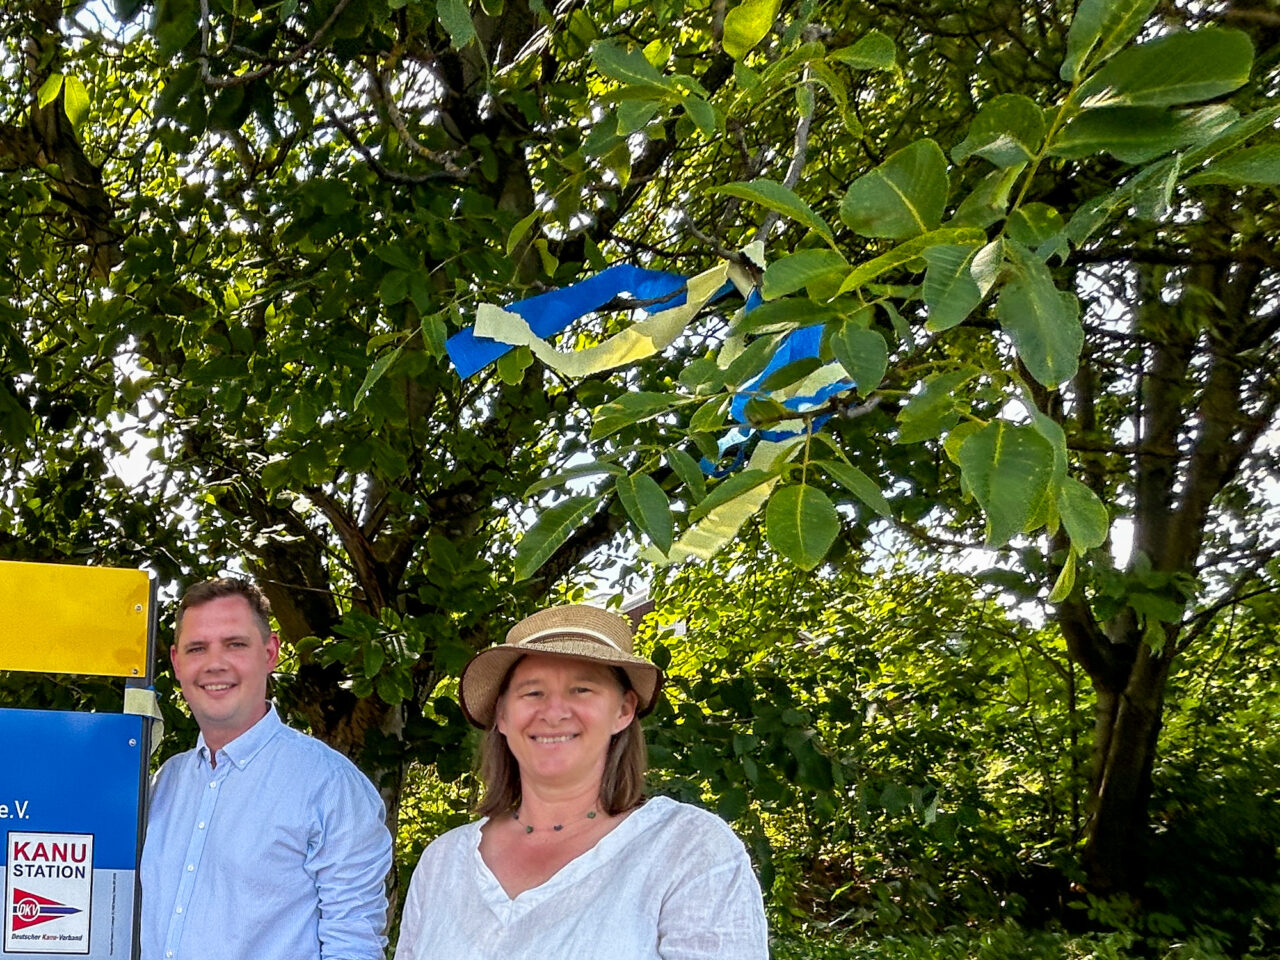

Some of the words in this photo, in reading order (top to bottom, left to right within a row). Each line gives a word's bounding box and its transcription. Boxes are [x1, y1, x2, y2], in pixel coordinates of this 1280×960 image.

[13, 841, 87, 863] KANU
[13, 863, 86, 879] STATION
[19, 903, 39, 916] DKV
[11, 933, 41, 941] Deutscher
